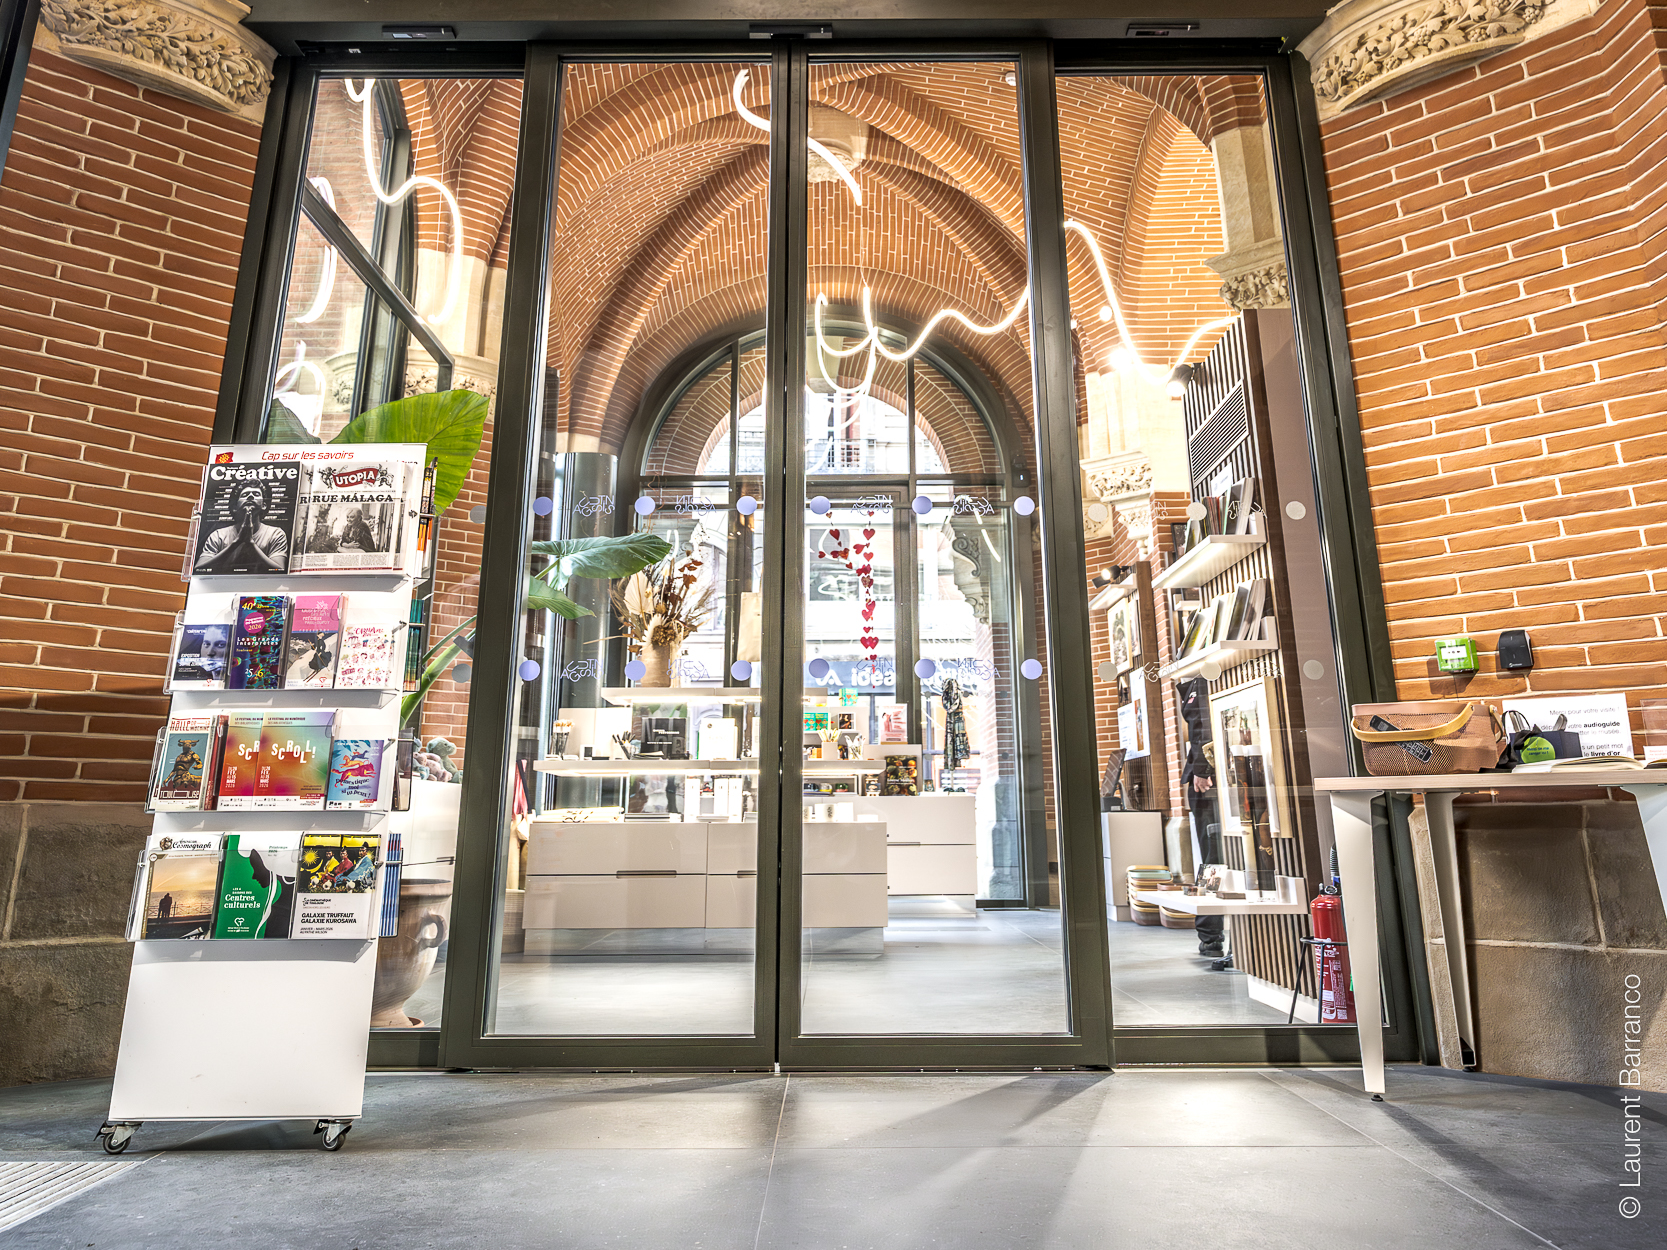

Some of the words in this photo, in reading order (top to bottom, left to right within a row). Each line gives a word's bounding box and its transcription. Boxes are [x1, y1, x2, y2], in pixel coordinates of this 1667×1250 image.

[262, 451, 280, 462] Cap
[282, 452, 300, 460] sur
[301, 451, 316, 460] les
[317, 450, 354, 460] savoirs
[210, 464, 298, 480] Créative
[335, 470, 375, 485] UTOPIA
[312, 494, 338, 503] RUE
[340, 492, 394, 502] MÁLAGA
[271, 740, 316, 764] SCROLL!
[172, 841, 212, 850] Cosmograph
